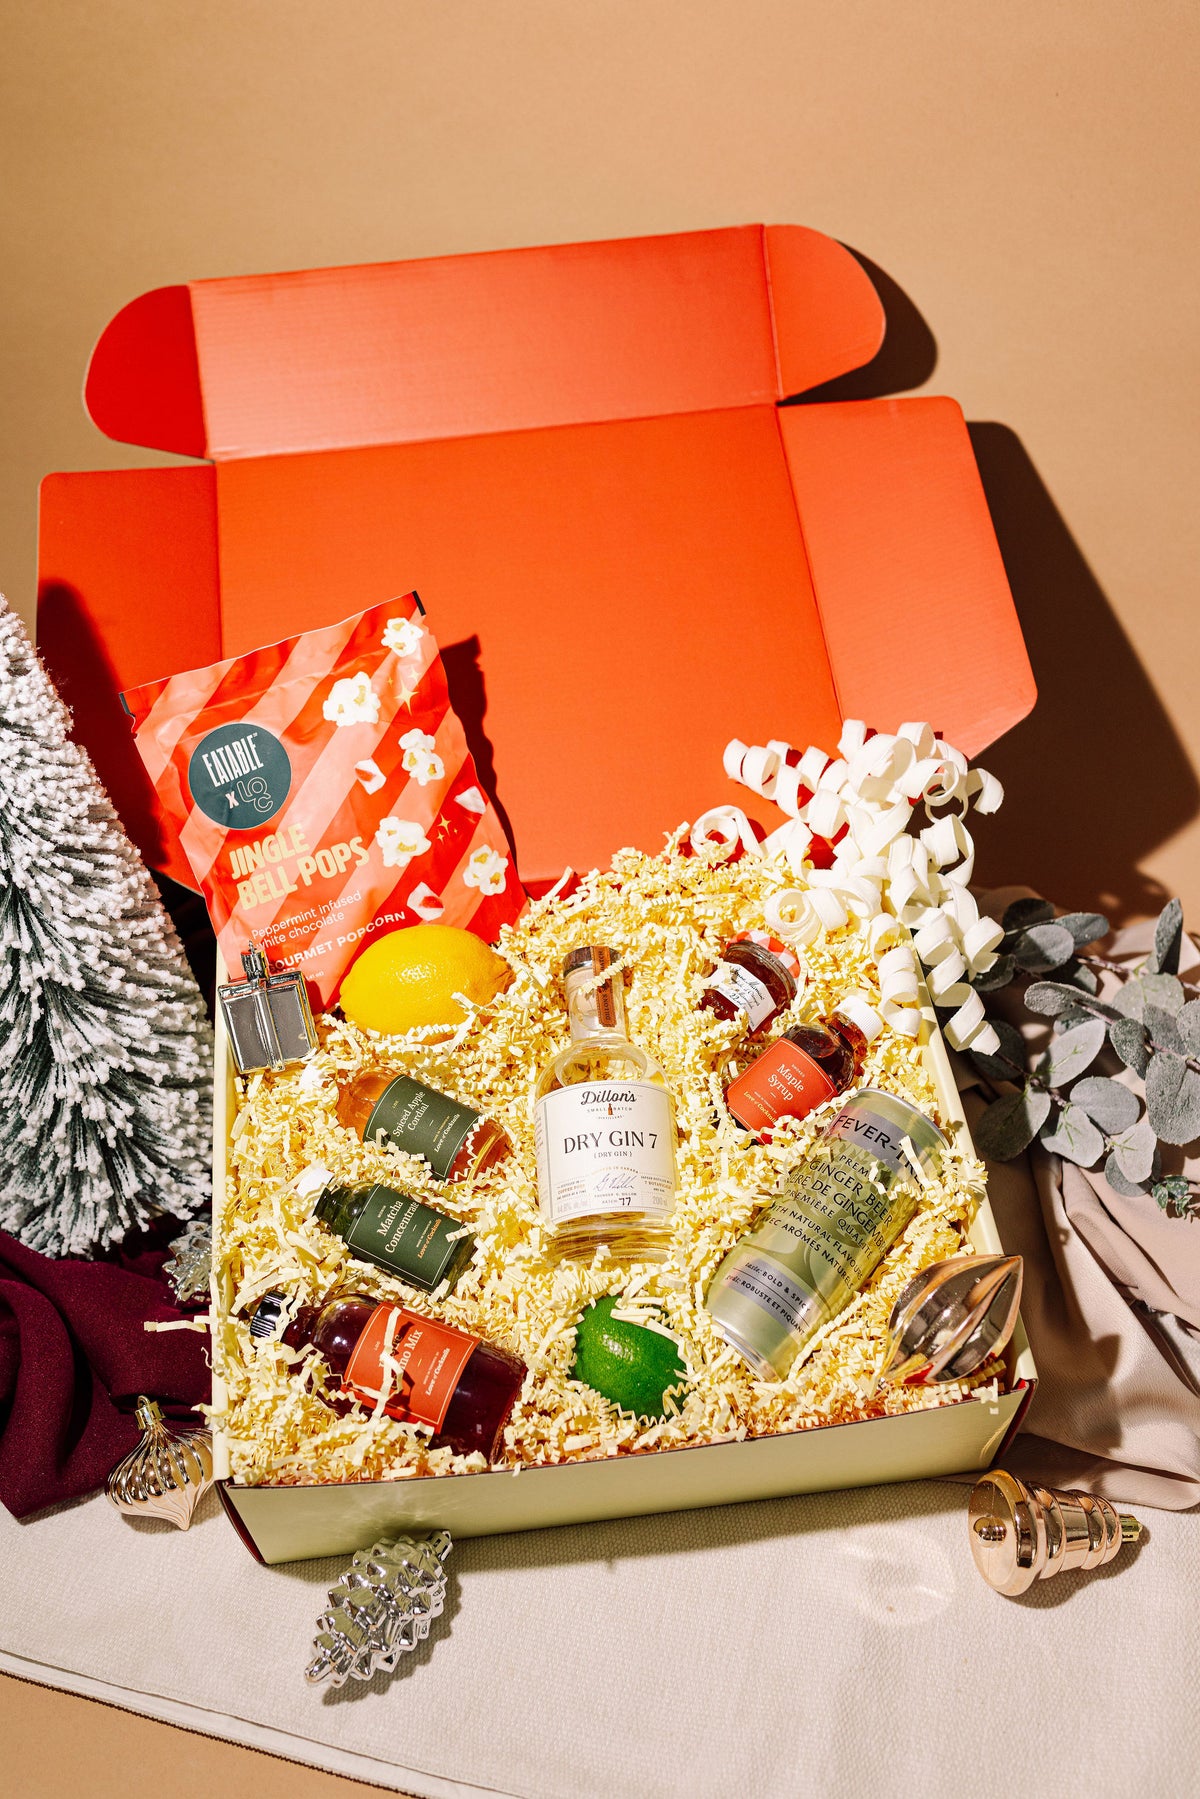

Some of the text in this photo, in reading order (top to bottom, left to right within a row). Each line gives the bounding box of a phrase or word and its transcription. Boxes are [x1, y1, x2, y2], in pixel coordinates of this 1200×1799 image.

[229, 823, 310, 880] JINGLE
[236, 836, 370, 911] BELL POPS
[251, 890, 362, 941] Peppermint infused
[255, 911, 345, 951] white chocolate
[336, 911, 406, 947] POPCORN
[766, 1072, 794, 1101] Syrup
[776, 1062, 805, 1093] Maple
[391, 1090, 426, 1137] Spiced Apple
[406, 1101, 429, 1131] Cordial
[580, 1090, 637, 1106] Dillon's
[756, 1102, 777, 1123] Cocktail
[433, 1137, 444, 1152] Love
[563, 1130, 658, 1154] DRY GIN 7
[618, 1196, 631, 1206] 77
[808, 1157, 894, 1227] GINGER BEER
[810, 1179, 832, 1197] DE
[375, 1199, 403, 1236] Matcha
[383, 1200, 420, 1254] Concentrate
[416, 1242, 427, 1259] Love
[780, 1221, 821, 1252] ARÔMES
[820, 1249, 854, 1290] NATURELS
[788, 1209, 833, 1243] NATURAL
[831, 1239, 863, 1280] FLAVOURS
[739, 1279, 772, 1303] ROBUSTE
[770, 1300, 781, 1310] ET
[779, 1308, 805, 1336] PIQUANT
[761, 1270, 784, 1288] BOLD
[782, 1285, 791, 1294] &
[789, 1291, 811, 1313] SPICY
[403, 1328, 423, 1350] Mix
[424, 1378, 435, 1396] Love
